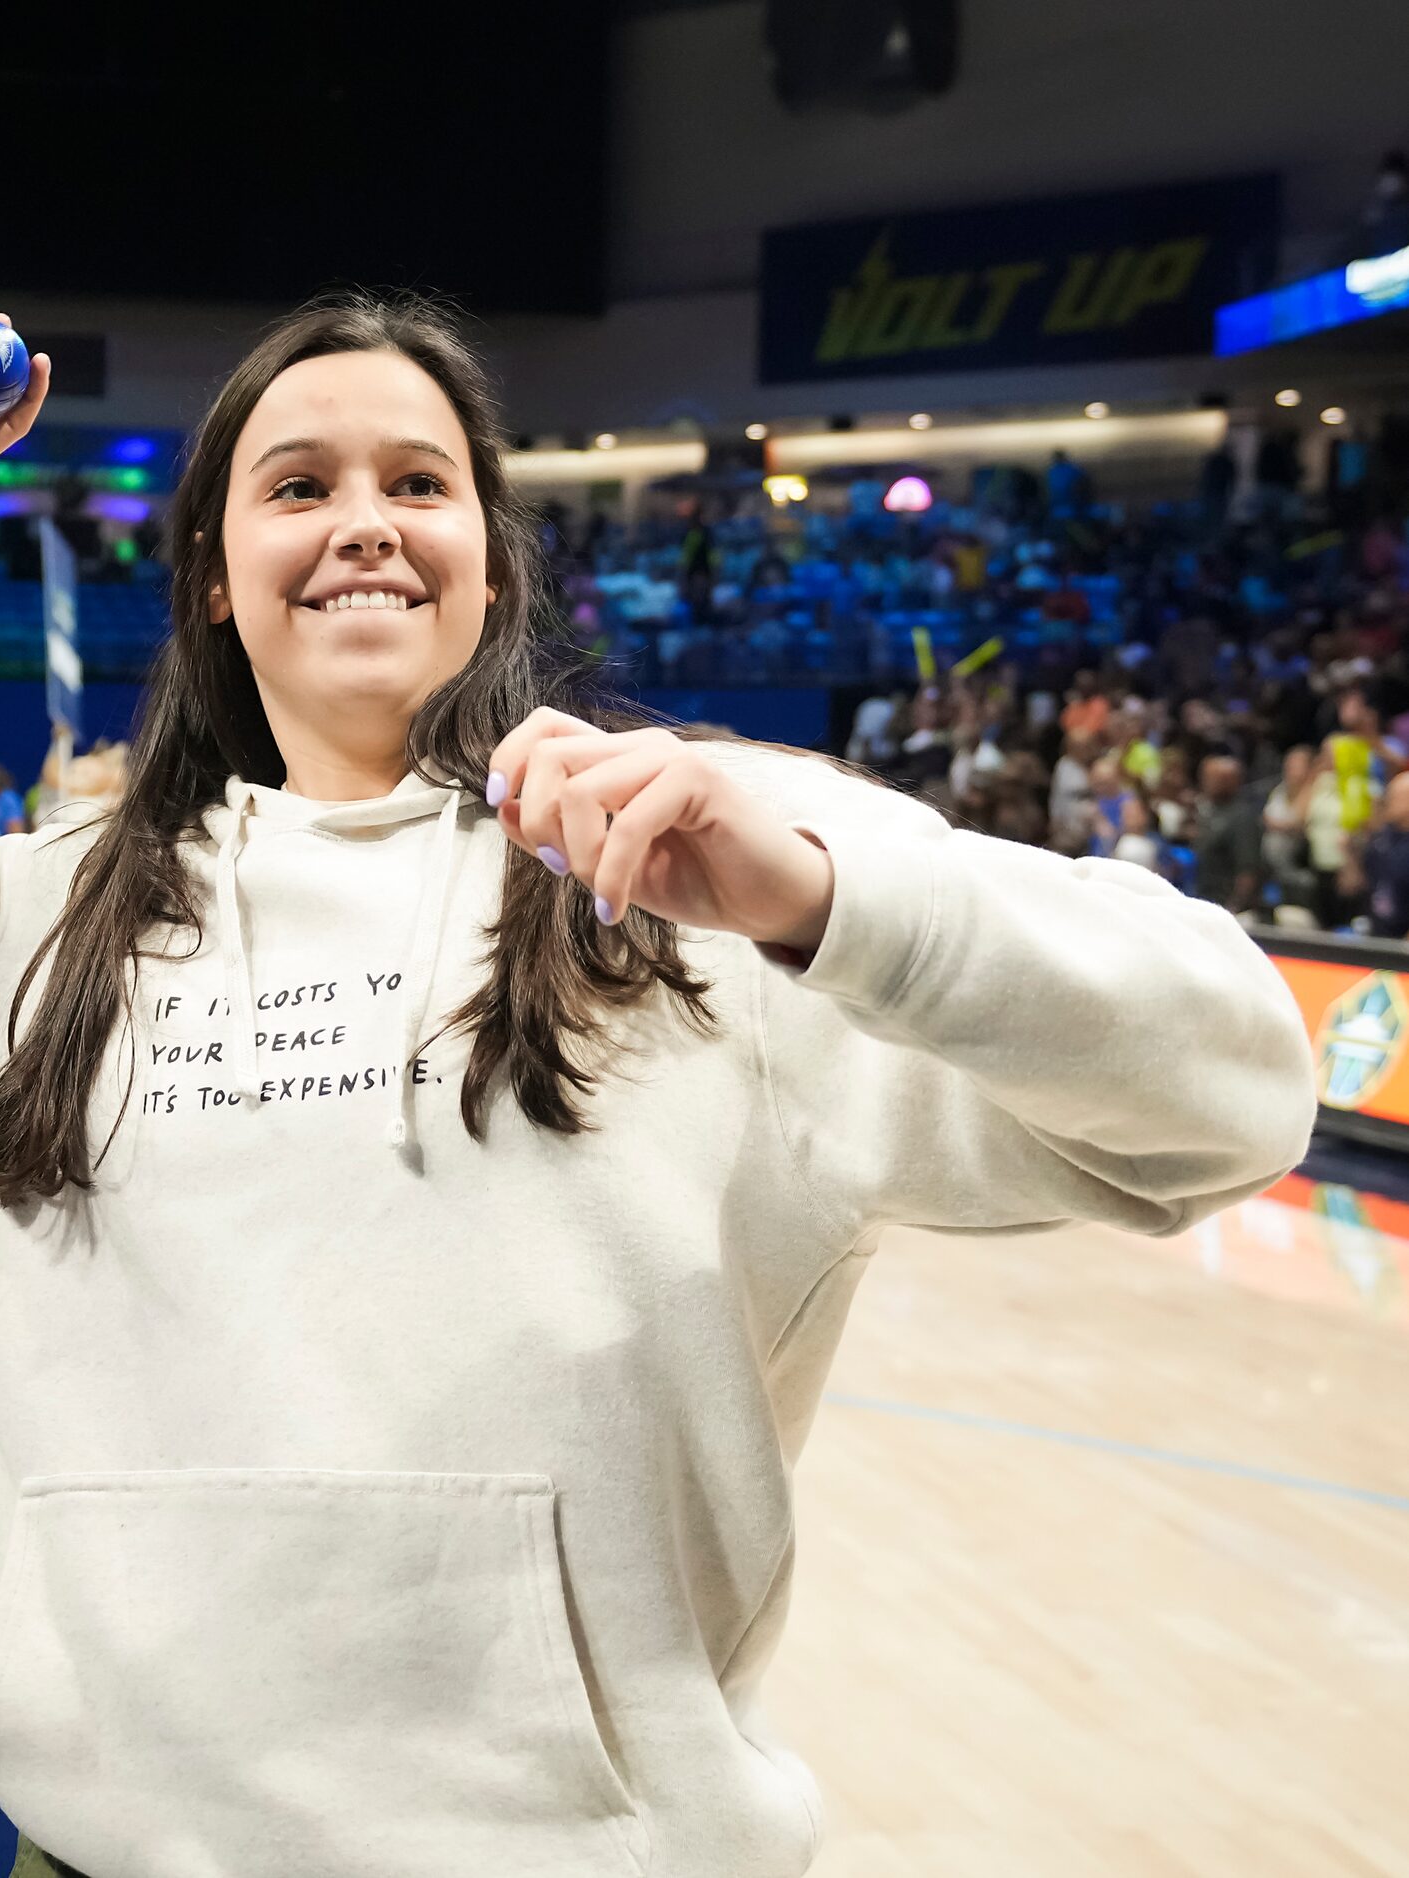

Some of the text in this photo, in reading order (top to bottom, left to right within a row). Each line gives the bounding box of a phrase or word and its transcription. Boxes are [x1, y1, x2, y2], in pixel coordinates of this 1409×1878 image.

[815, 222, 1048, 363] VOLT
[1044, 233, 1212, 337] UP
[155, 996, 183, 1022] IF
[257, 981, 338, 1010] COSTS
[151, 1025, 347, 1065] YOUR PEACE
[142, 1084, 179, 1115] IT'S
[259, 1058, 443, 1103] EXPENSIE.
